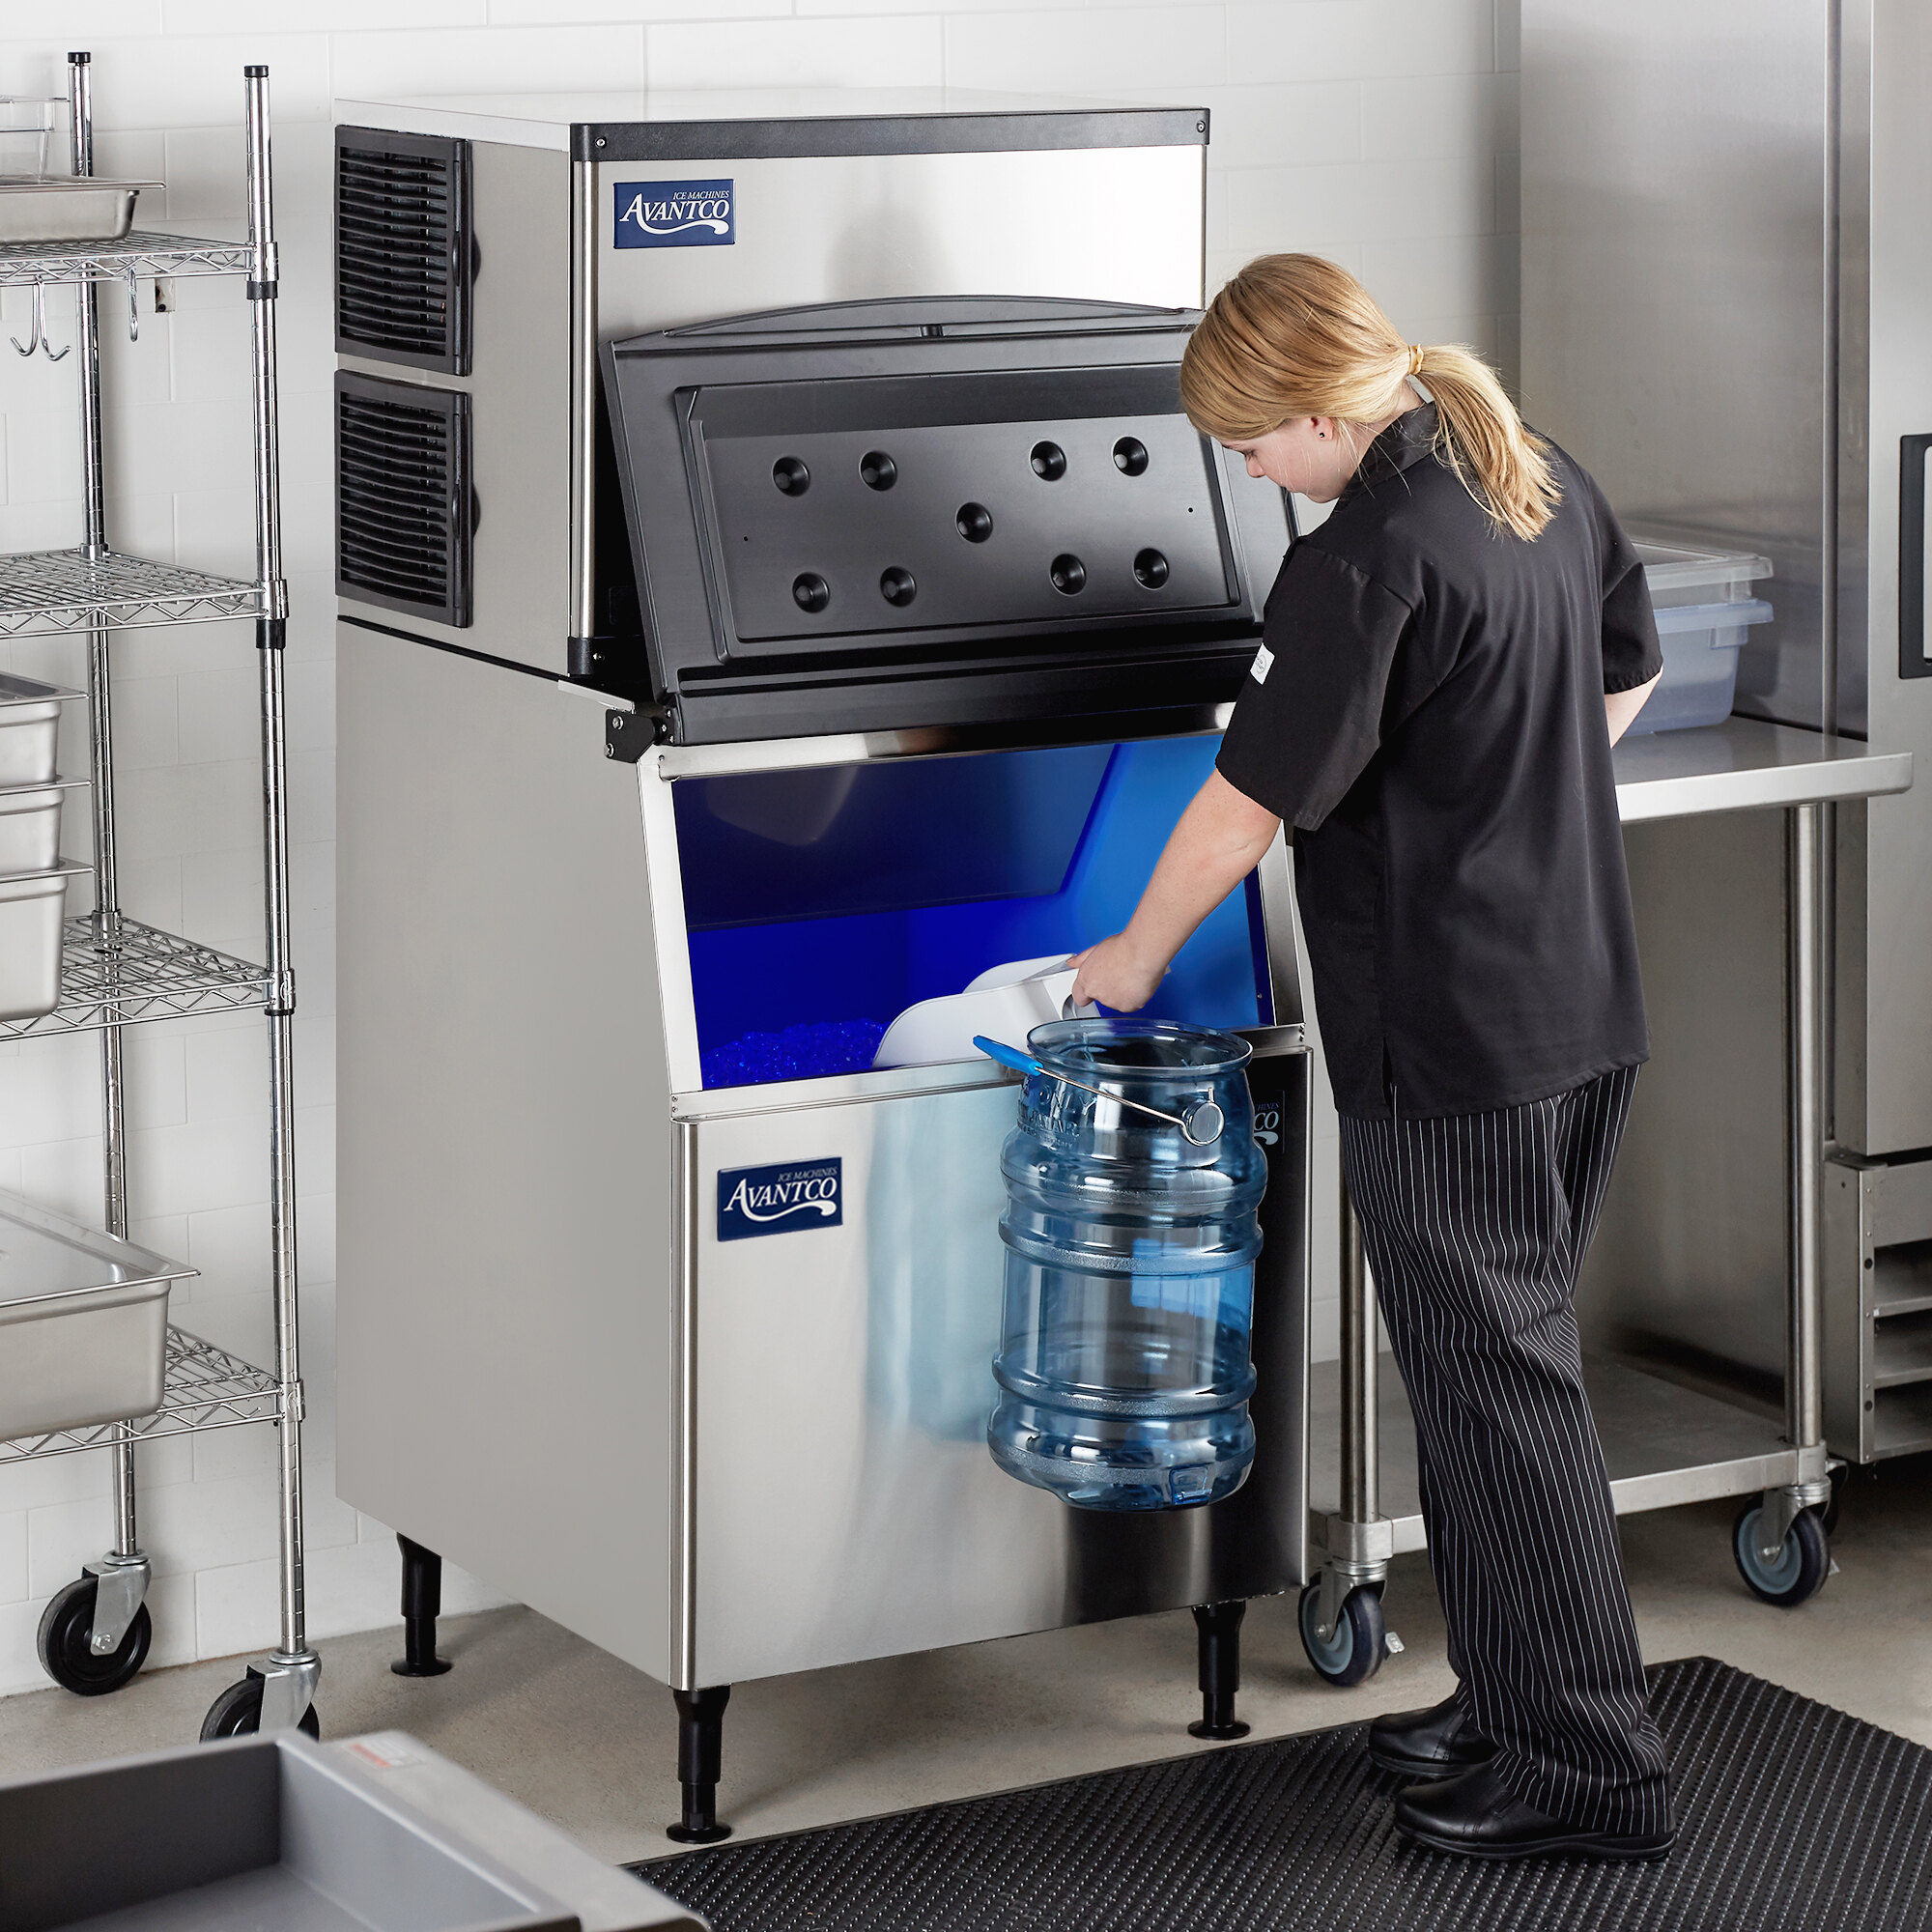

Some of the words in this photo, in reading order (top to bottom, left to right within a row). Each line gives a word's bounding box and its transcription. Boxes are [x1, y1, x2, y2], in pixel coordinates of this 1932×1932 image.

[688, 190, 730, 200] MACHINES
[619, 193, 730, 235] AVANTCO
[1253, 1110, 1280, 1131] CO
[778, 1173, 793, 1182] ICE
[793, 1167, 838, 1179] MACHINES
[724, 1177, 838, 1222] AVANTCO
